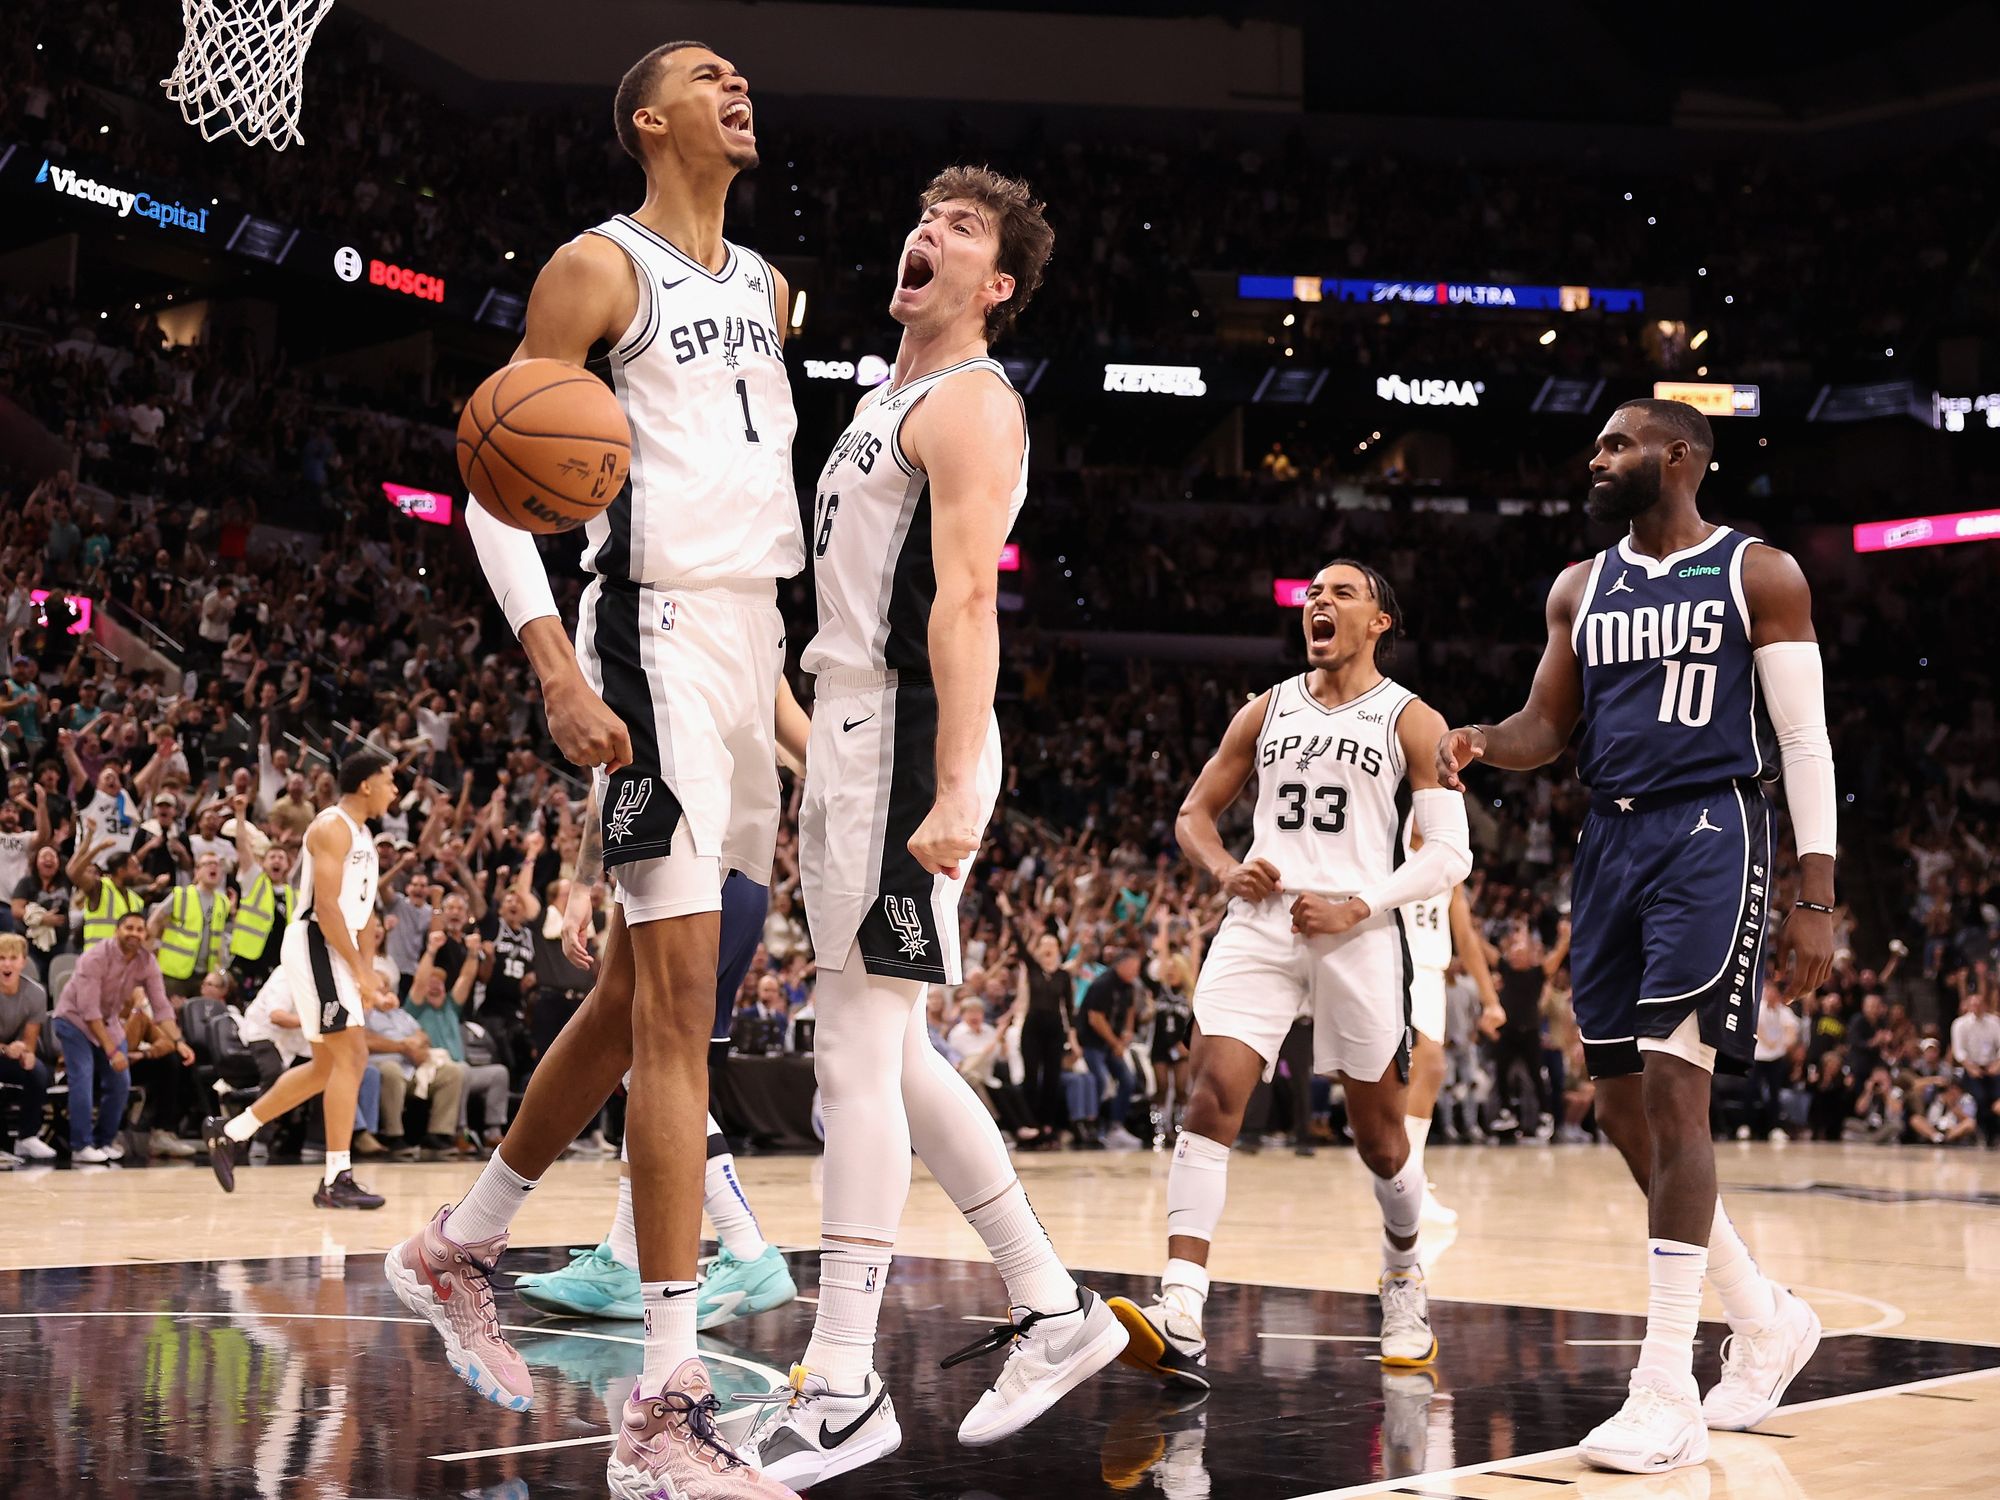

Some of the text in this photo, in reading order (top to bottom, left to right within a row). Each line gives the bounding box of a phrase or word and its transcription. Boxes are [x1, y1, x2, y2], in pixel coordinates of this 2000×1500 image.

[369, 259, 444, 303] BOSCH
[1449, 285, 1516, 305] ULTRA
[803, 360, 855, 379] TACO
[735, 378, 760, 443] 1
[1678, 564, 1721, 578] chime
[1586, 600, 1725, 667] MAVS
[1657, 659, 1718, 728] 10
[1357, 710, 1384, 726] Self.
[1263, 735, 1383, 777] SPURS
[1276, 781, 1350, 836] 33
[1415, 903, 1439, 930] 24
